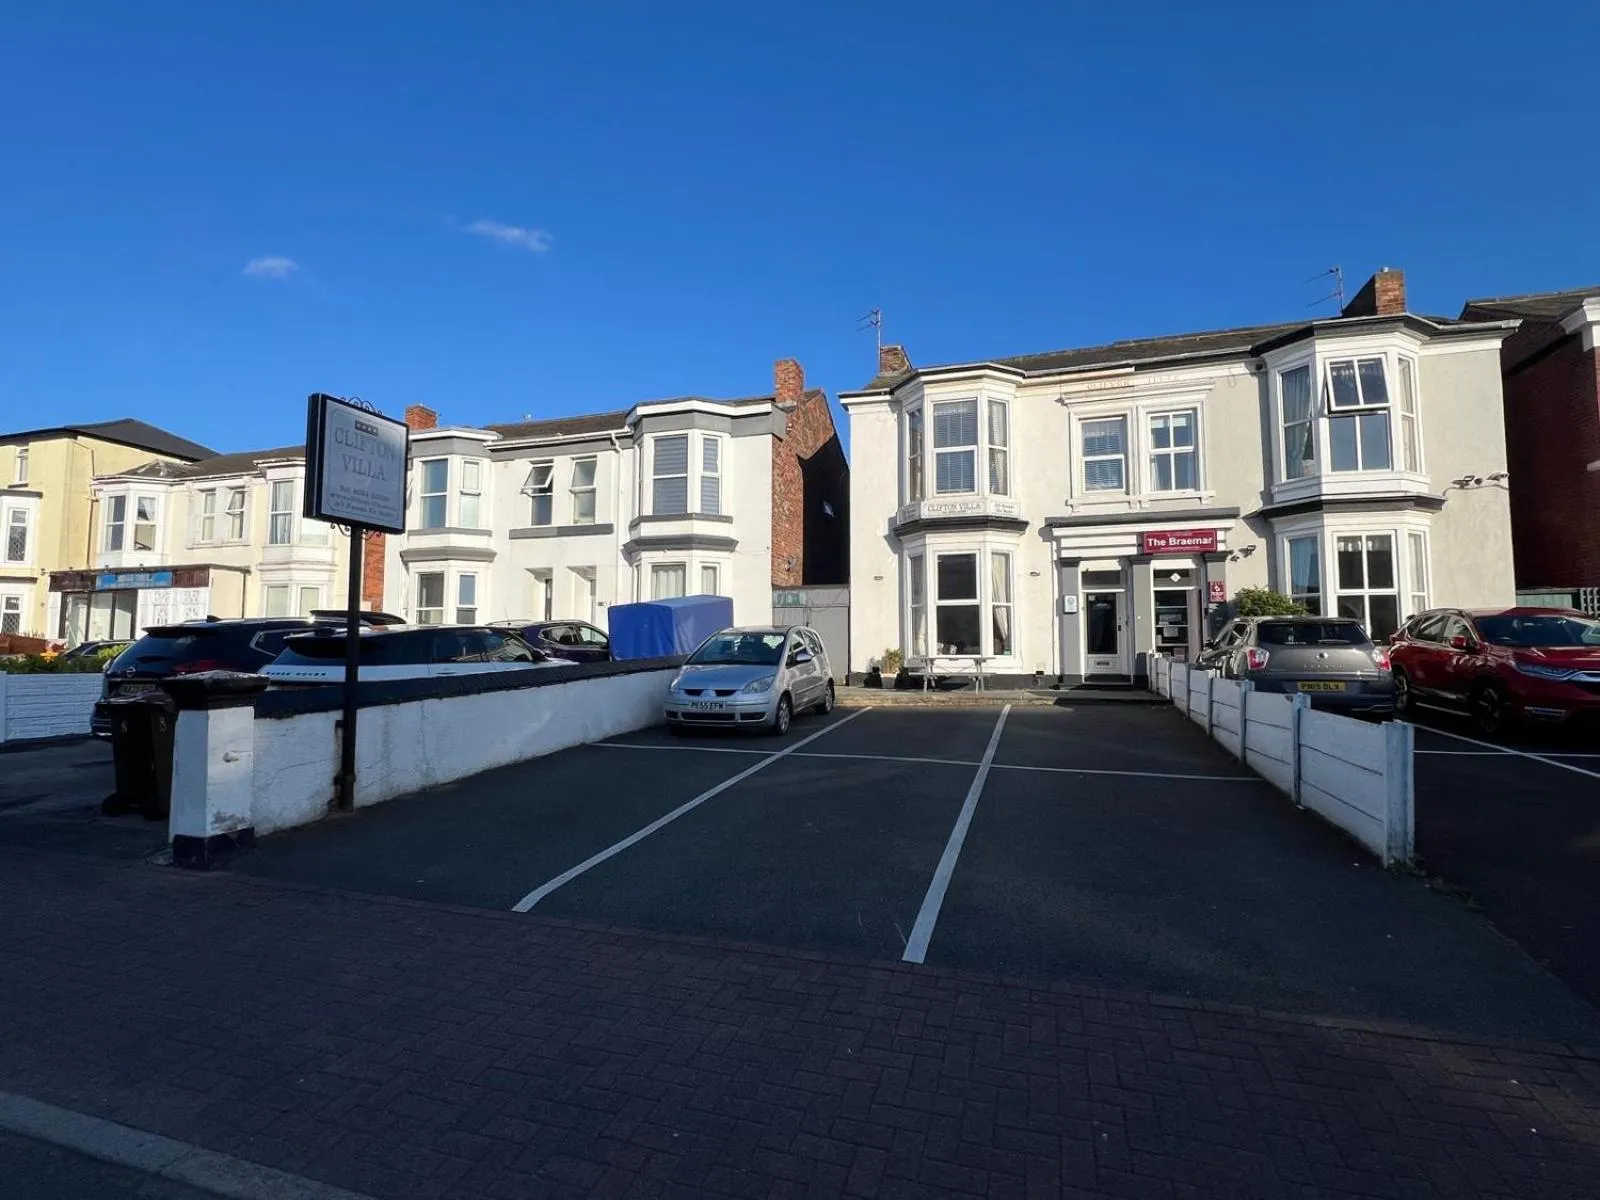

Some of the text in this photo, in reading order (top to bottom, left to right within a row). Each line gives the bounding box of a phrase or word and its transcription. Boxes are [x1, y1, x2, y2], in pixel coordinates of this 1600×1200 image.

[334, 427, 396, 461] CLIFTON
[342, 454, 386, 481] VILLA
[927, 503, 958, 512] CLIFTON
[959, 502, 982, 511] VILLA
[1147, 537, 1213, 547] The Braemar
